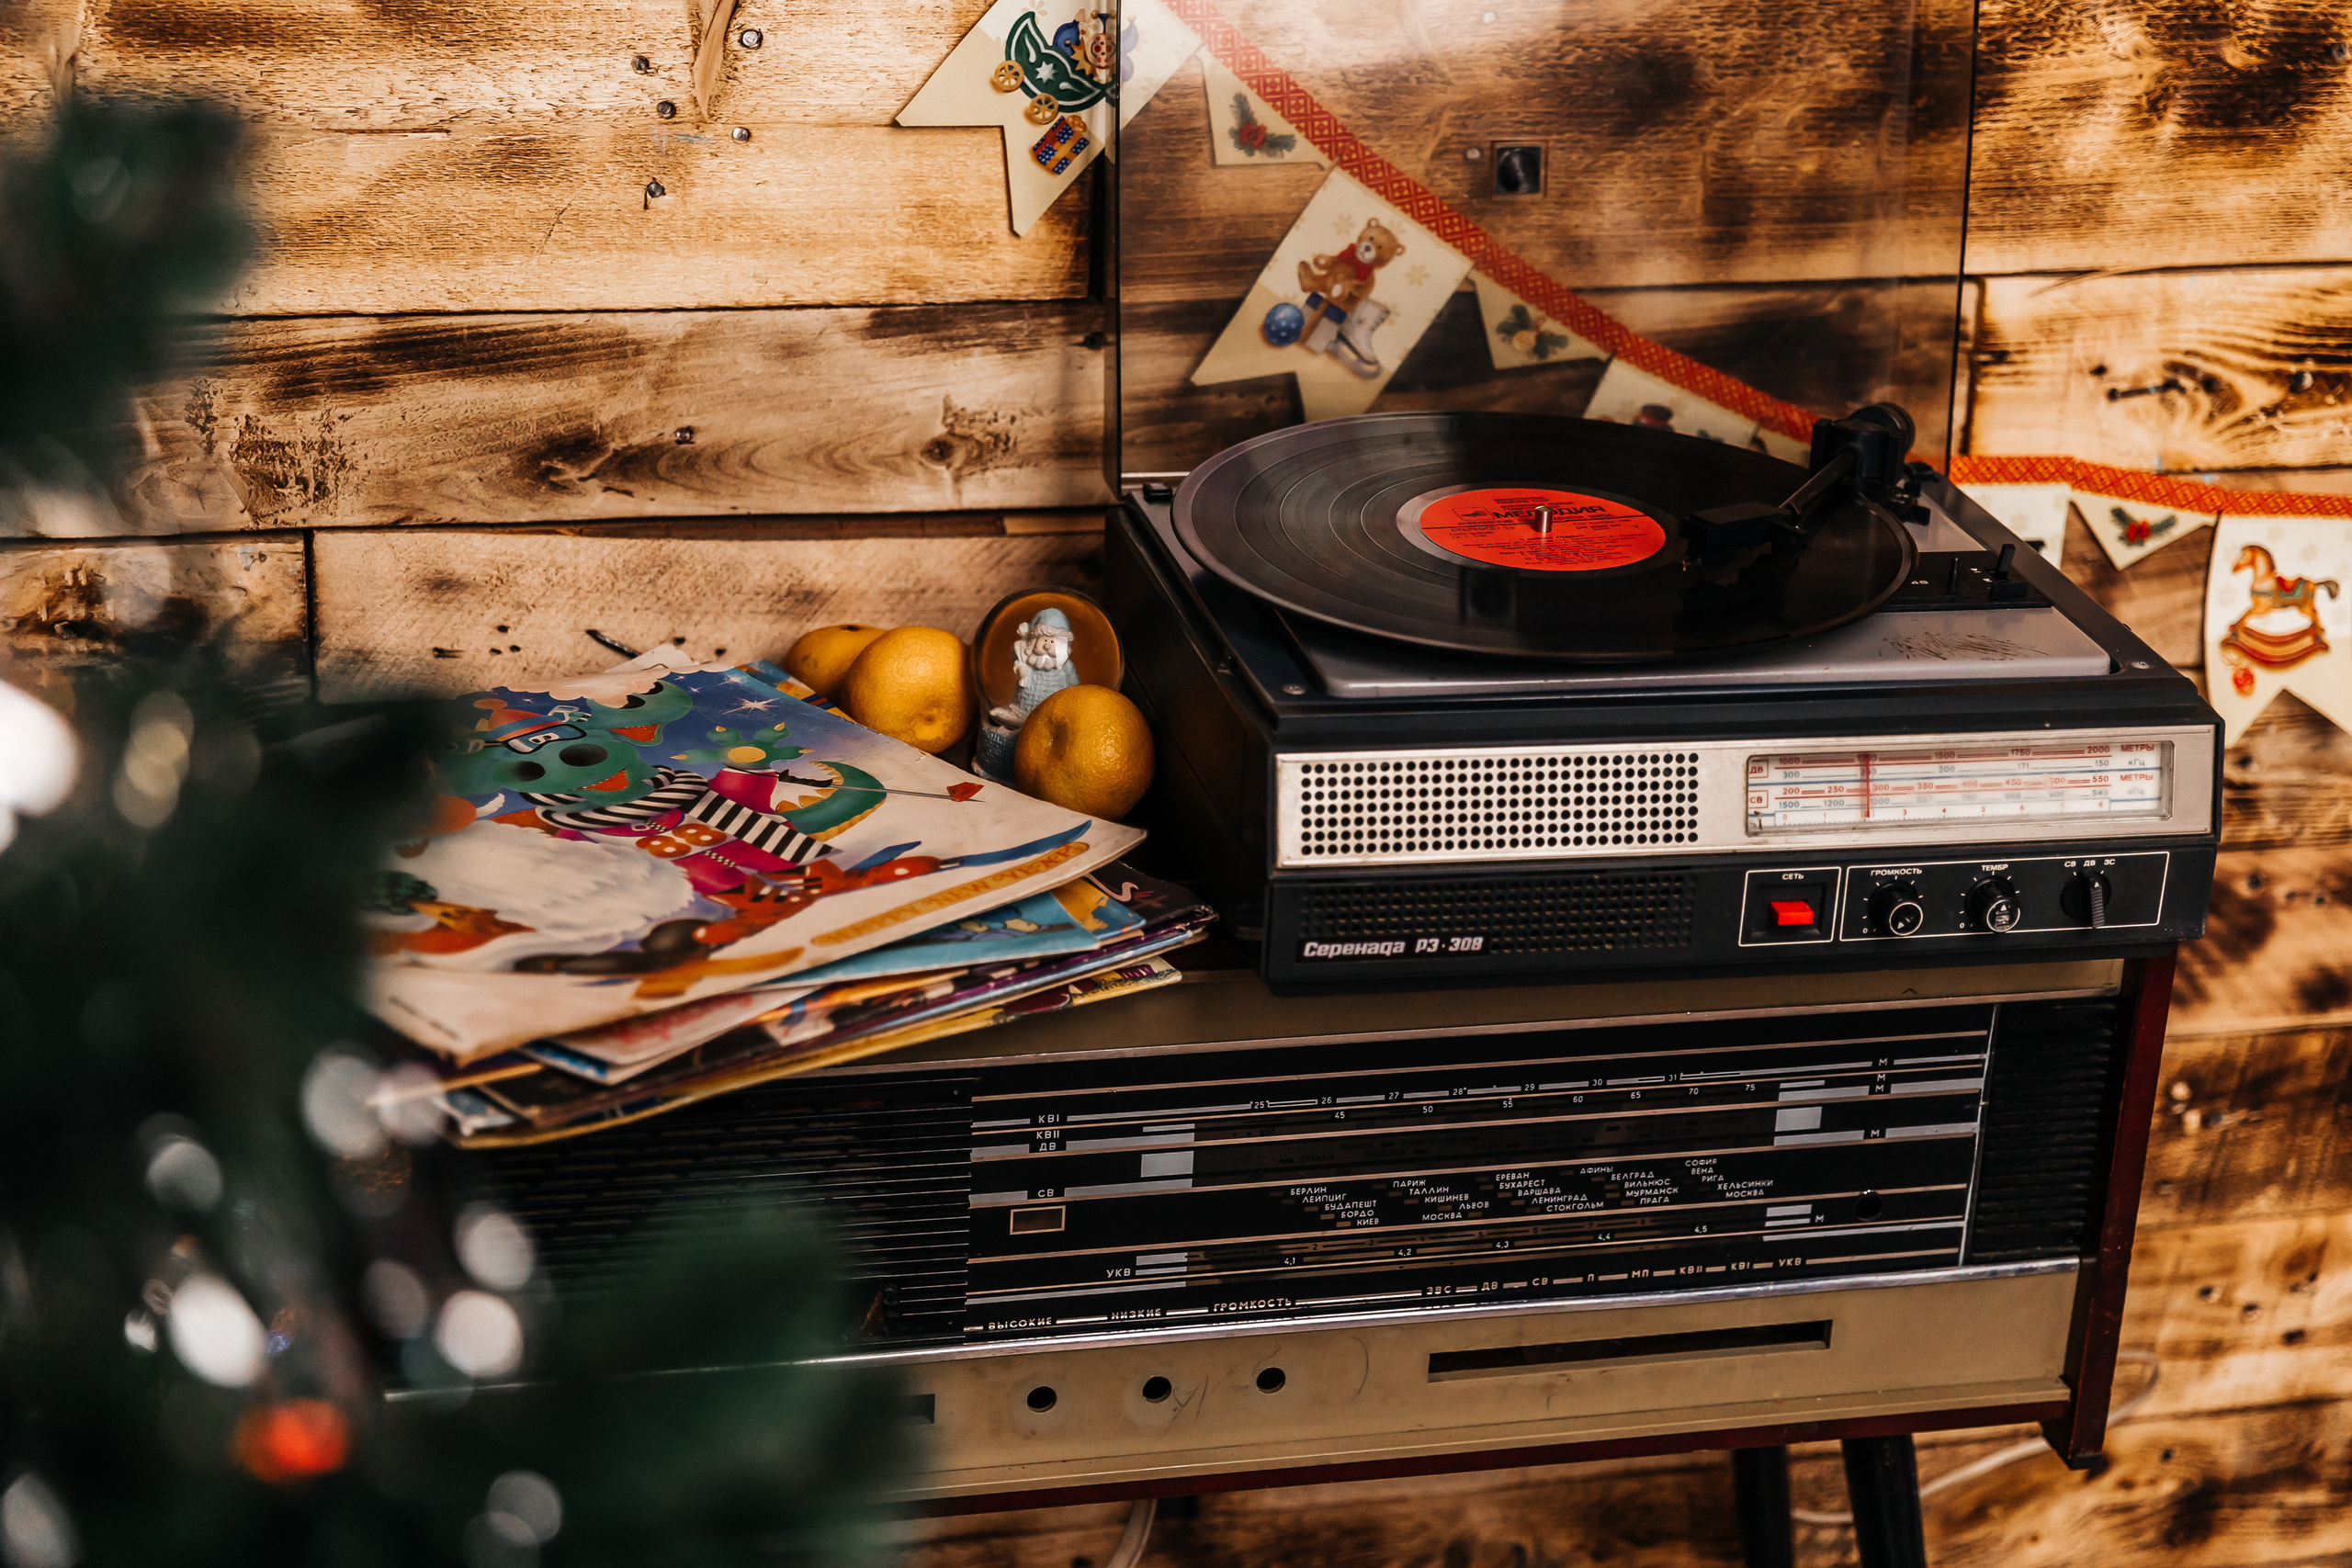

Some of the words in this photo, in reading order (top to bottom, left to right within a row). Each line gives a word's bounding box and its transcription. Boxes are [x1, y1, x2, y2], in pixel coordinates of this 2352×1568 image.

[2121, 744, 2154, 752] МЕТРЫ
[1750, 766, 1763, 774] ДВ
[1872, 784, 1890, 792] 300
[1981, 863, 2008, 873] ТЕМБР
[2064, 860, 2076, 868] СВ
[1781, 873, 1804, 881] СЕТЬ
[1871, 867, 1923, 877] ГРОМКОСТЬ
[1254, 1100, 1265, 1110] 25
[1321, 1096, 1332, 1105] 26
[1388, 1091, 1399, 1100] 27
[1453, 1087, 1464, 1096] 28
[1524, 1083, 1535, 1091] 29
[1592, 1078, 1603, 1087] 30
[1668, 1074, 1677, 1082] 31
[1334, 1111, 1345, 1119] 45
[1422, 1105, 1433, 1113] 50
[1502, 1100, 1513, 1109] 55
[1572, 1095, 1584, 1103] 60
[1630, 1090, 1641, 1100] 65
[1746, 1083, 1756, 1091] 75
[1038, 1142, 1057, 1152] ДВ
[1685, 1158, 1717, 1168] СОФИЯ
[1579, 1166, 1614, 1176] АФИНЫ
[1690, 1167, 1713, 1175] ВЕНА
[1495, 1171, 1531, 1182] ЕРЕВАН
[1611, 1171, 1655, 1182] БЕЛГРАД
[1702, 1174, 1724, 1182] РИГА
[1393, 1179, 1427, 1190] ПАРИЖ
[1499, 1179, 1545, 1190] БУХАРЕСТ
[1623, 1178, 1671, 1189] ВИЛЬНЮС
[1717, 1179, 1774, 1190] ХЕЛЬСИНКИ
[1037, 1189, 1054, 1198] СВ
[1290, 1186, 1328, 1197] БЕРЛИН
[1408, 1186, 1450, 1196] ТАЛЛИН
[1517, 1187, 1561, 1198] ВАРШАВА
[1625, 1187, 1679, 1198] МУРМАНСК
[1725, 1189, 1764, 1198] МОСКВА
[1302, 1193, 1348, 1204] ЛЕЙПЦИГ
[1424, 1193, 1469, 1204] КИШИНЕВ
[1532, 1193, 1589, 1205] ЛЕНИНГРАД
[1639, 1196, 1669, 1205] ПРАГА
[1325, 1200, 1377, 1212] БУДАПЕШТ
[1459, 1201, 1489, 1210] ЛЬВОВ
[1545, 1201, 1605, 1213] СТОКГОЛЬМ
[1340, 1209, 1375, 1220] БОРДО
[1422, 1212, 1463, 1221] МОСКВА
[1356, 1217, 1379, 1226] КИЕВ
[1283, 1257, 1295, 1266] 4.1
[1397, 1247, 1412, 1256] 4.2
[1496, 1240, 1510, 1249] 4.3
[1694, 1224, 1708, 1233] 4.5
[1106, 1268, 1131, 1278] УКВ
[988, 1316, 1053, 1331] ВЫСОКИЕ
[1110, 1308, 1162, 1321] НИЗКИЕ
[1212, 1298, 1293, 1312] ГРОМКОСТЬ
[1481, 1281, 1498, 1292] ДВ
[1532, 1277, 1548, 1286] СВ
[1587, 1273, 1595, 1281] П
[1631, 1269, 1649, 1279] МП
[1779, 1257, 1802, 1268] УКВ
